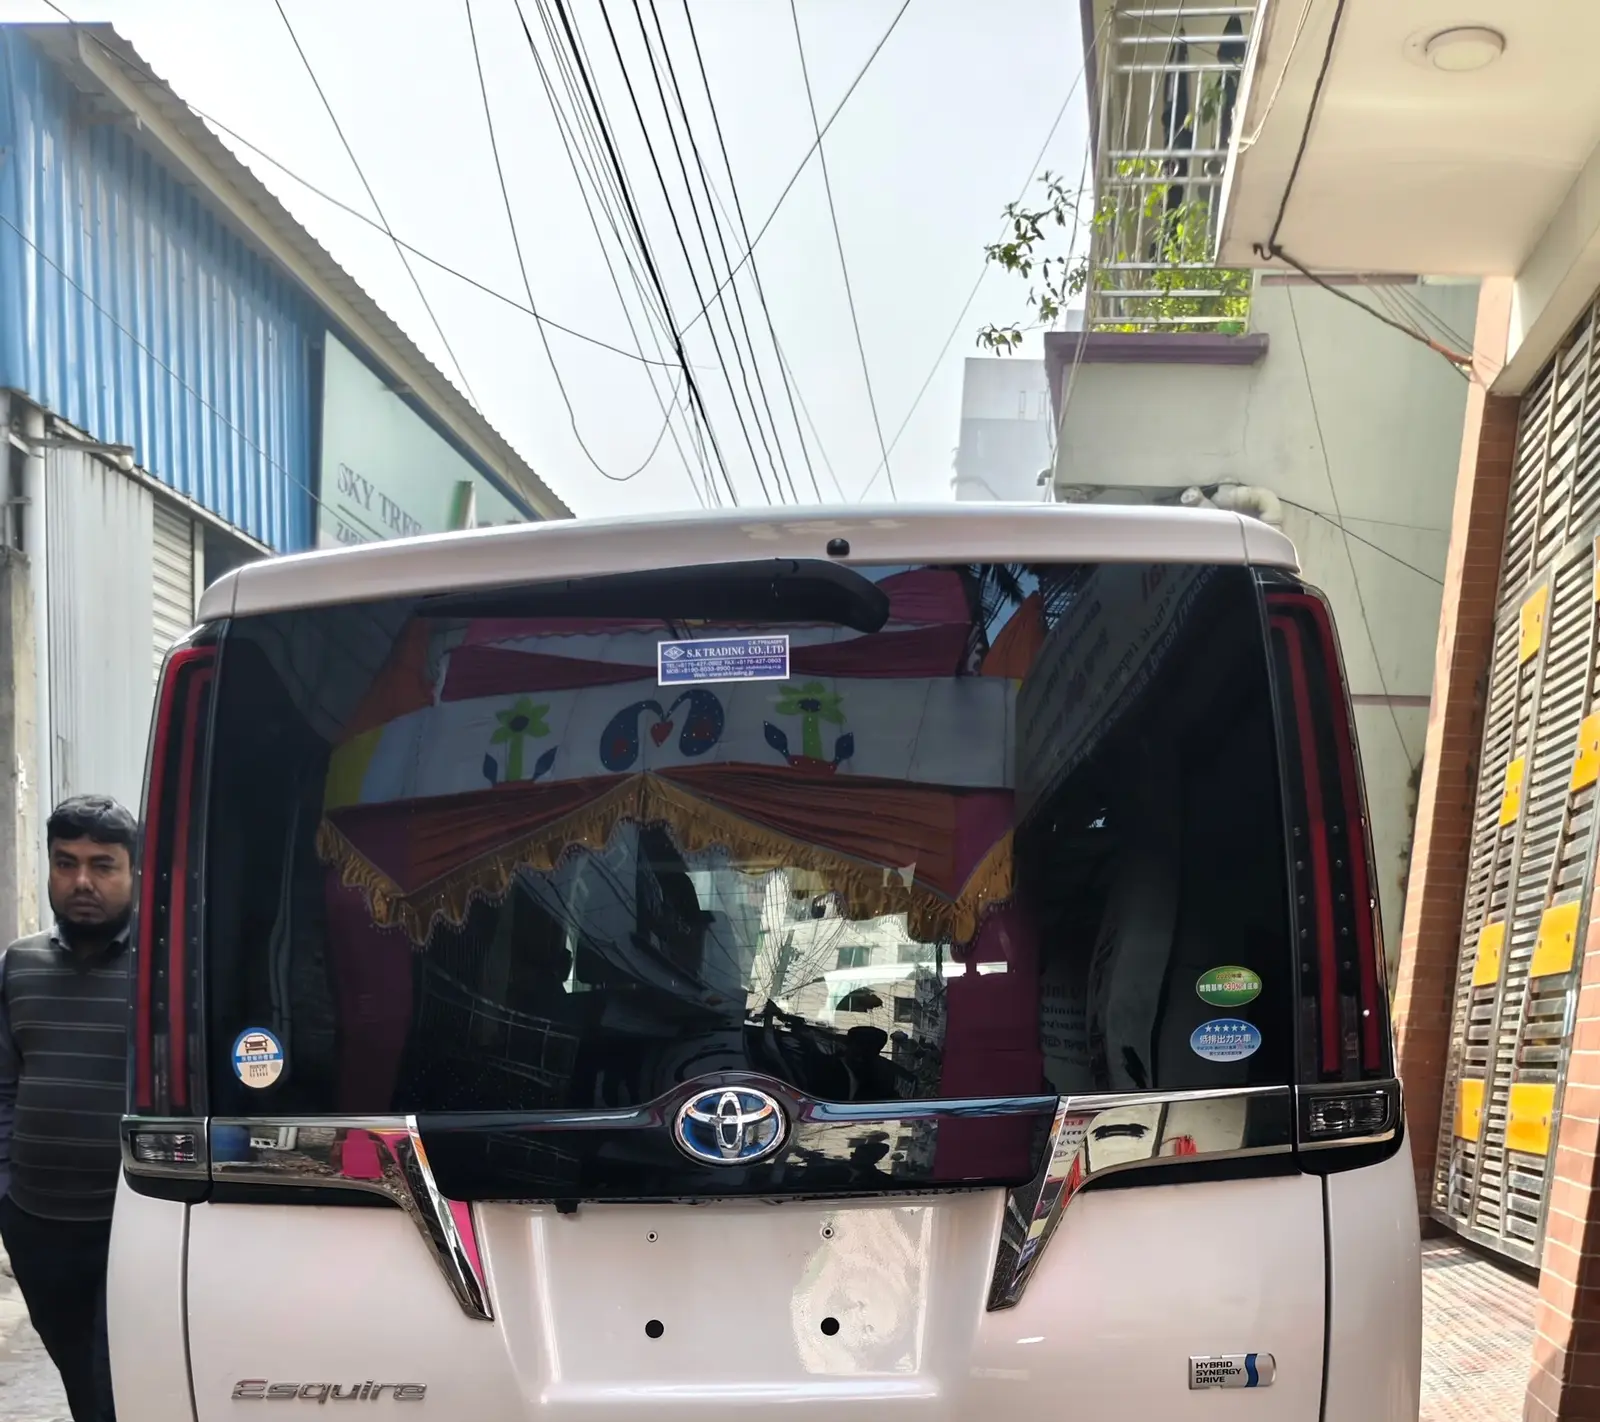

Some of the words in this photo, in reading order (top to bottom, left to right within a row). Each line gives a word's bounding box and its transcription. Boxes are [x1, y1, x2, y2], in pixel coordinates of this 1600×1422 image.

[338, 462, 375, 512] SKY
[686, 648, 702, 658] S.K
[702, 646, 745, 657] TRADING
[1196, 1361, 1233, 1369] HYBRID
[1195, 1368, 1242, 1376] SYNERGY
[1195, 1376, 1226, 1384] DRIVE
[231, 1378, 428, 1405] Esquire
